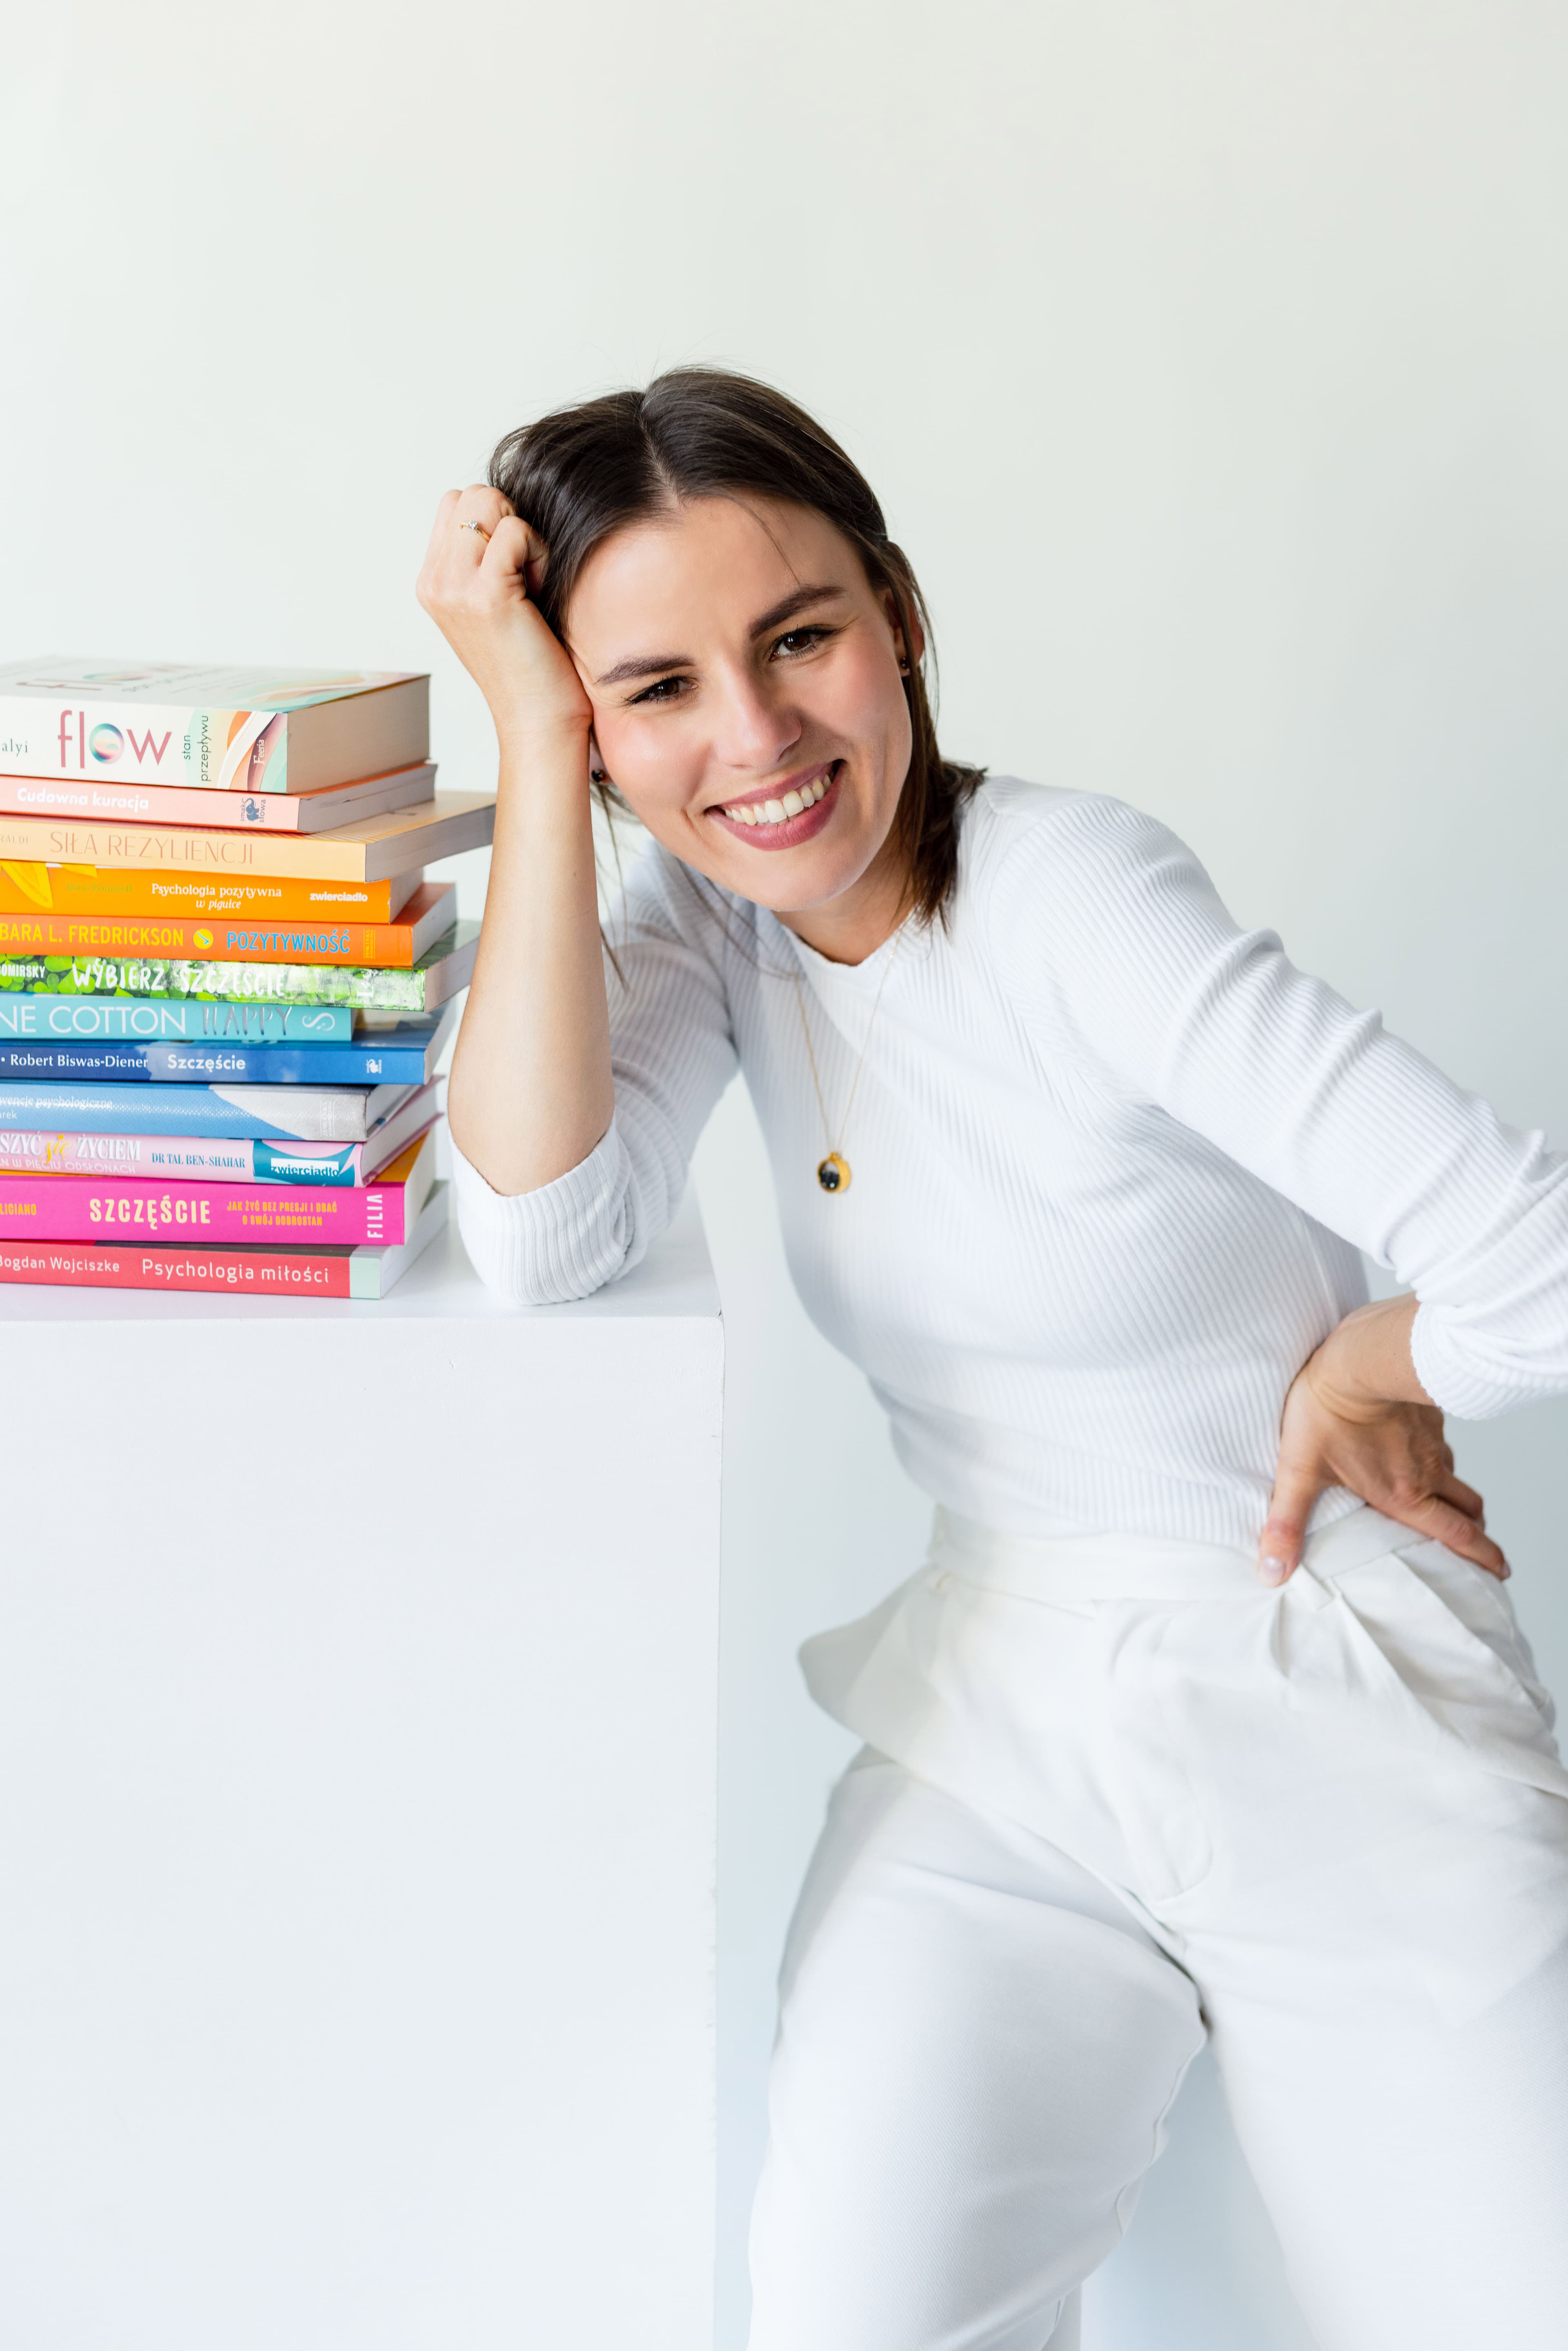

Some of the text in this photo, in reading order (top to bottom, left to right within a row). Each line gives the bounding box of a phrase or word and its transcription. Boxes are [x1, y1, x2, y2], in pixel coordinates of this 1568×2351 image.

[2, 738, 29, 757] alyi
[58, 709, 172, 769] flow
[182, 735, 191, 760] stan
[197, 715, 212, 782] przepływu
[253, 739, 265, 764] Feeria
[17, 787, 149, 813] Cudowna kuracja
[50, 831, 253, 865] SIŁA REZYLIENCJI
[67, 883, 90, 891] Ilona
[151, 883, 282, 898] Psychologia pozytywna
[196, 898, 241, 911] w pigułce
[0, 923, 184, 947] BARA L. FREDRICKSON
[227, 929, 350, 953] POZYTYWNOŚĆ
[0, 963, 46, 979] OMIRSKY
[71, 963, 285, 998] WYBIERZ SZCZĘŚCIE
[0, 1005, 186, 1035] NE COTTON
[202, 1005, 292, 1036] HAPPY
[11, 1054, 149, 1068] Robert Biswas-Diener
[167, 1054, 246, 1073] Szczęście
[35, 1095, 113, 1110] psychologiczne
[0, 1130, 142, 1164] SZYĆ się ŻYCIEM
[25, 1159, 61, 1170] PIĘCIU
[65, 1161, 136, 1174] ODSŁONACH
[152, 1152, 246, 1168] DR TAL BEN-SHAHAR
[0, 1203, 37, 1215] LICIANO
[89, 1194, 211, 1230] SZCZĘŚCIE
[227, 1199, 338, 1213] JAK ŻYĆ BEZ PRESJI I DBAĆ
[367, 1194, 383, 1238] FILIA
[242, 1213, 323, 1226] O SWÓJ DOBROSTAN
[49, 1256, 120, 1274] Wojciszke
[142, 1258, 329, 1284] Psychologia miłości
